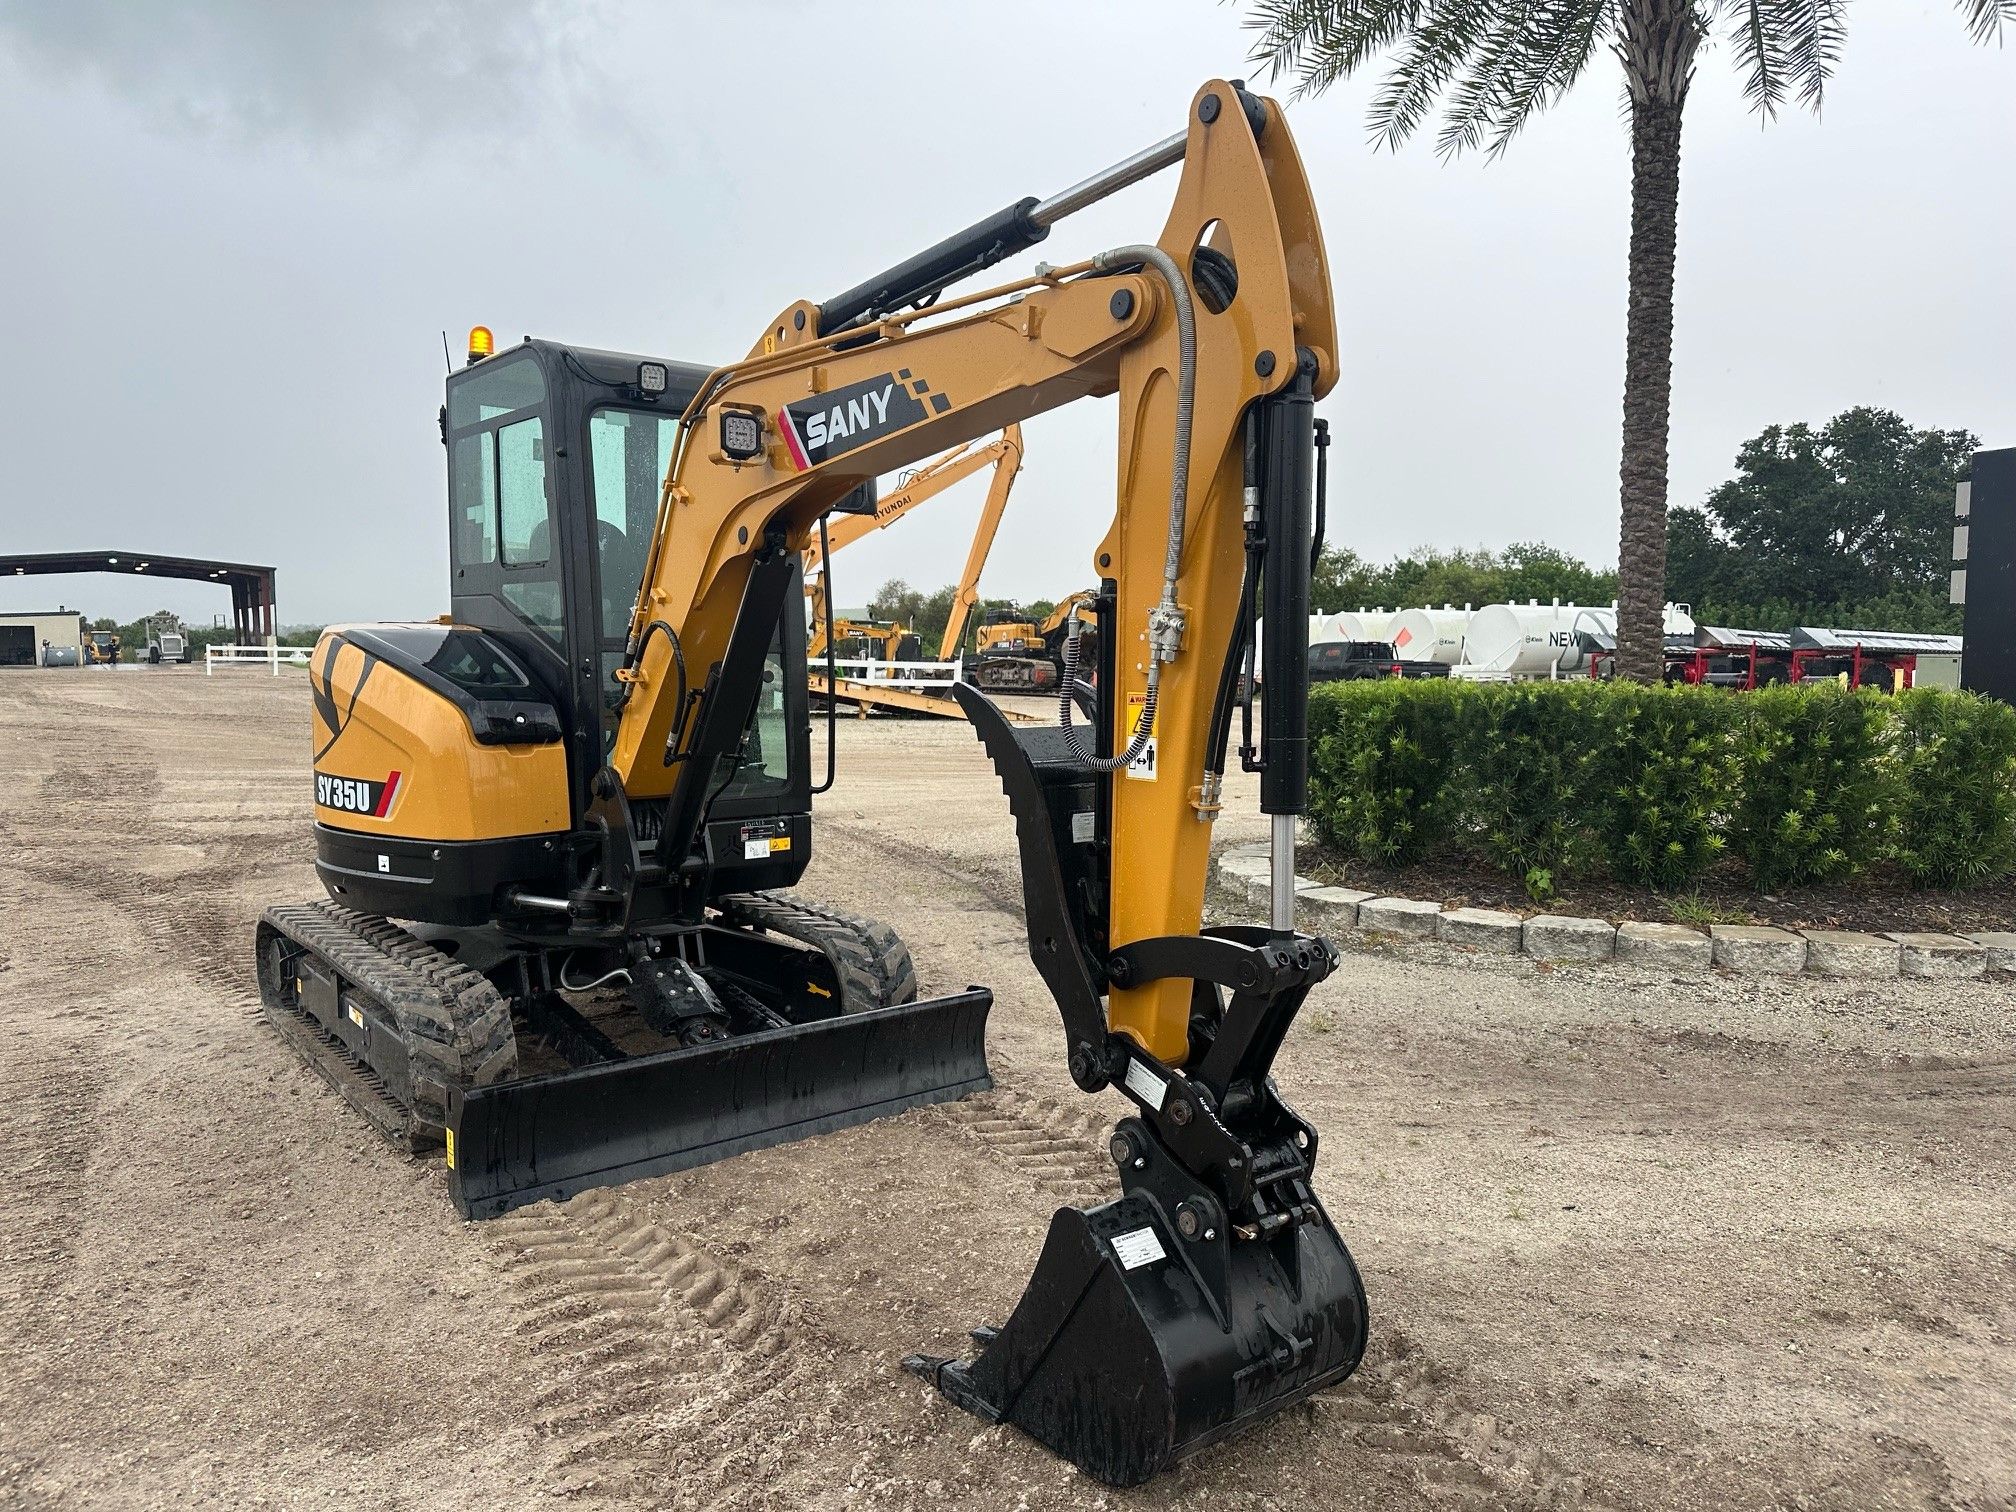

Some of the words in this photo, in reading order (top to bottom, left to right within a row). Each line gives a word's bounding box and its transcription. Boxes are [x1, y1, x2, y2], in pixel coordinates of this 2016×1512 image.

[806, 383, 894, 450] SANY
[873, 495, 912, 520] HYUNDAI
[1549, 631, 1582, 647] NEW
[318, 775, 370, 812] SY35U
